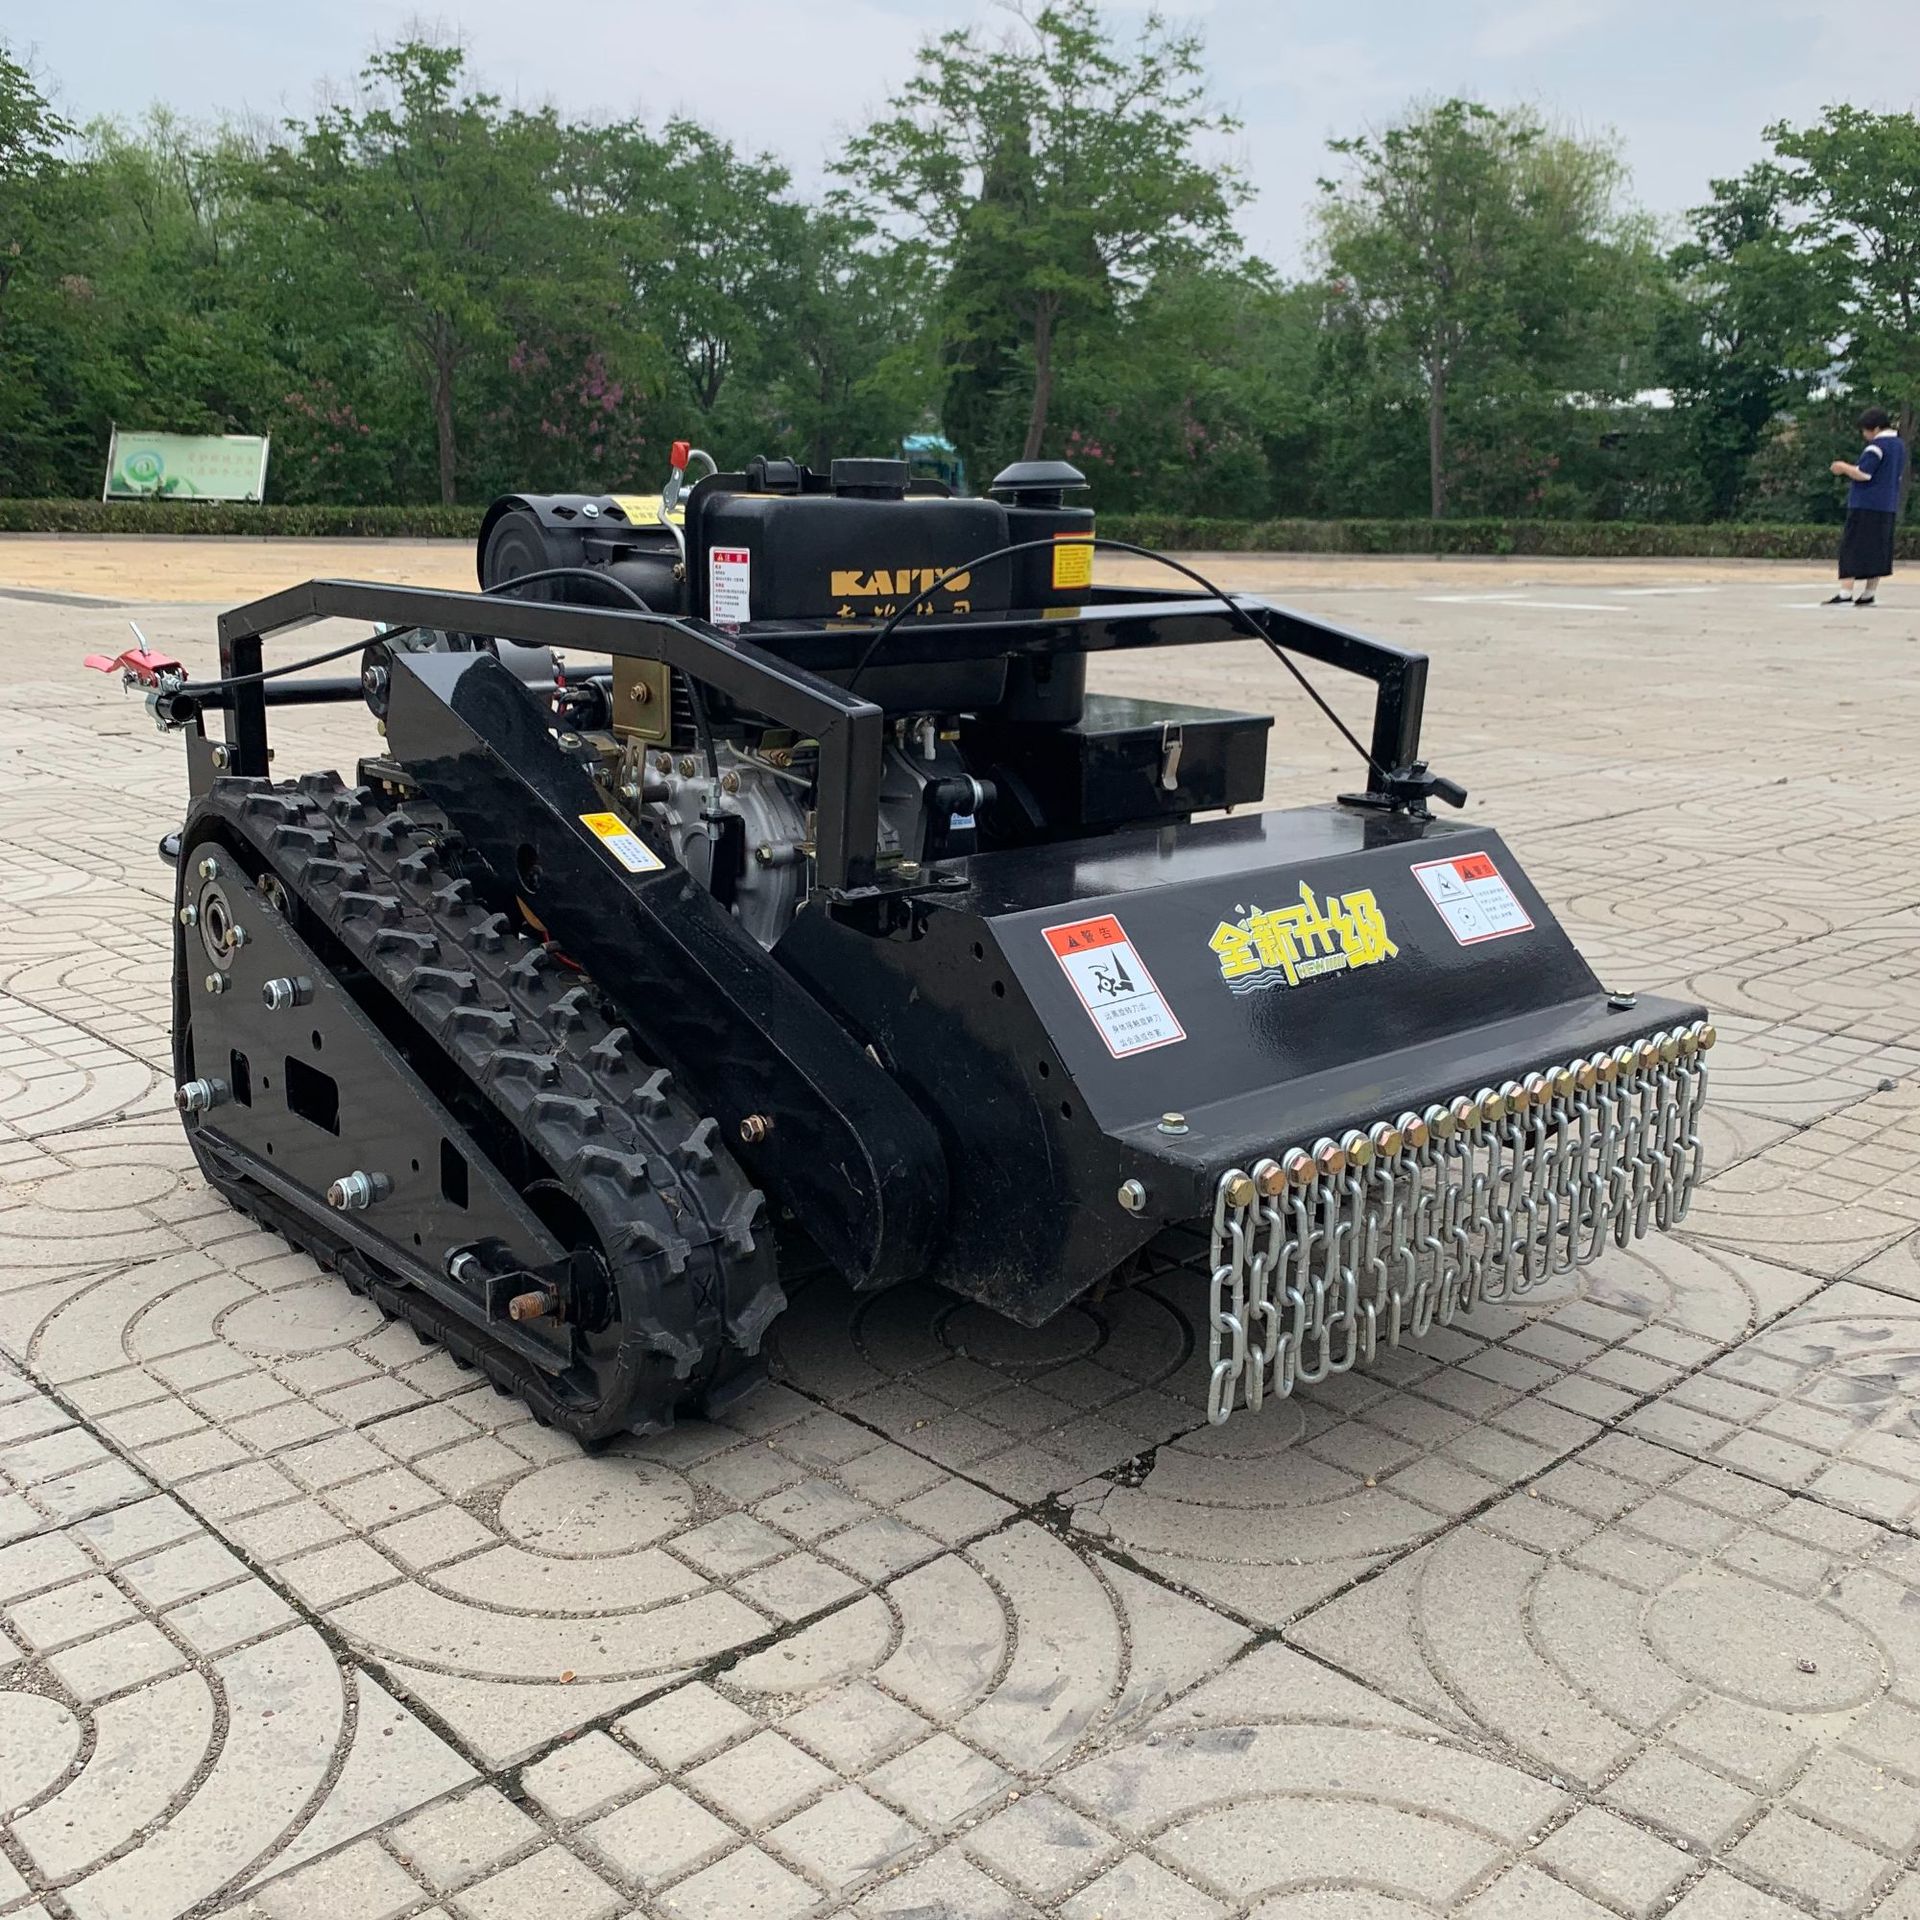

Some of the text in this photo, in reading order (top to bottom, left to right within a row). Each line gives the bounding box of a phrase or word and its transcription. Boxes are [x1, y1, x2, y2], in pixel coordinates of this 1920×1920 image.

[1080, 926, 1112, 944] 警告
[1208, 880, 1399, 986] 全新升级
